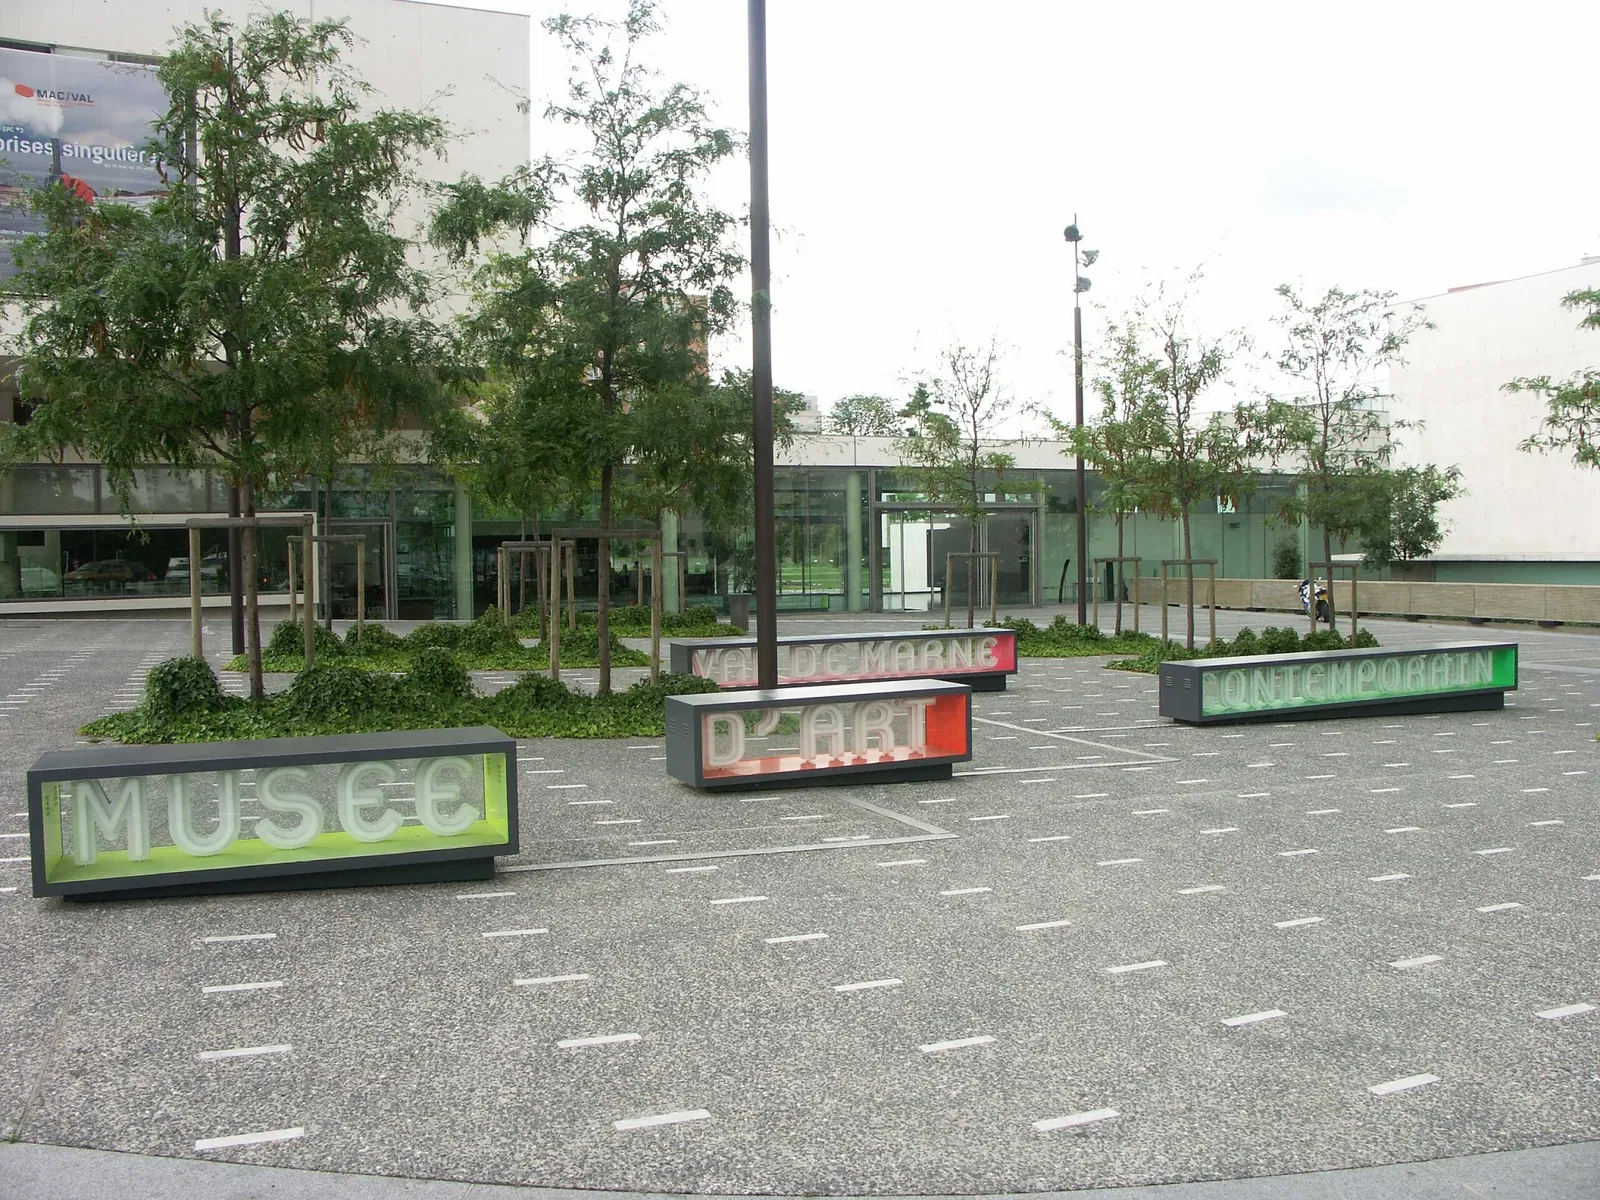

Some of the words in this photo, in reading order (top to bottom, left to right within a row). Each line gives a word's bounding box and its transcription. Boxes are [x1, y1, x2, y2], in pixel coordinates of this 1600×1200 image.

[37, 89, 94, 103] MAC/VAL
[790, 643, 848, 679] DE
[859, 637, 998, 675] MARNE
[701, 698, 936, 768] D'ART
[73, 757, 480, 867] MUSEE
